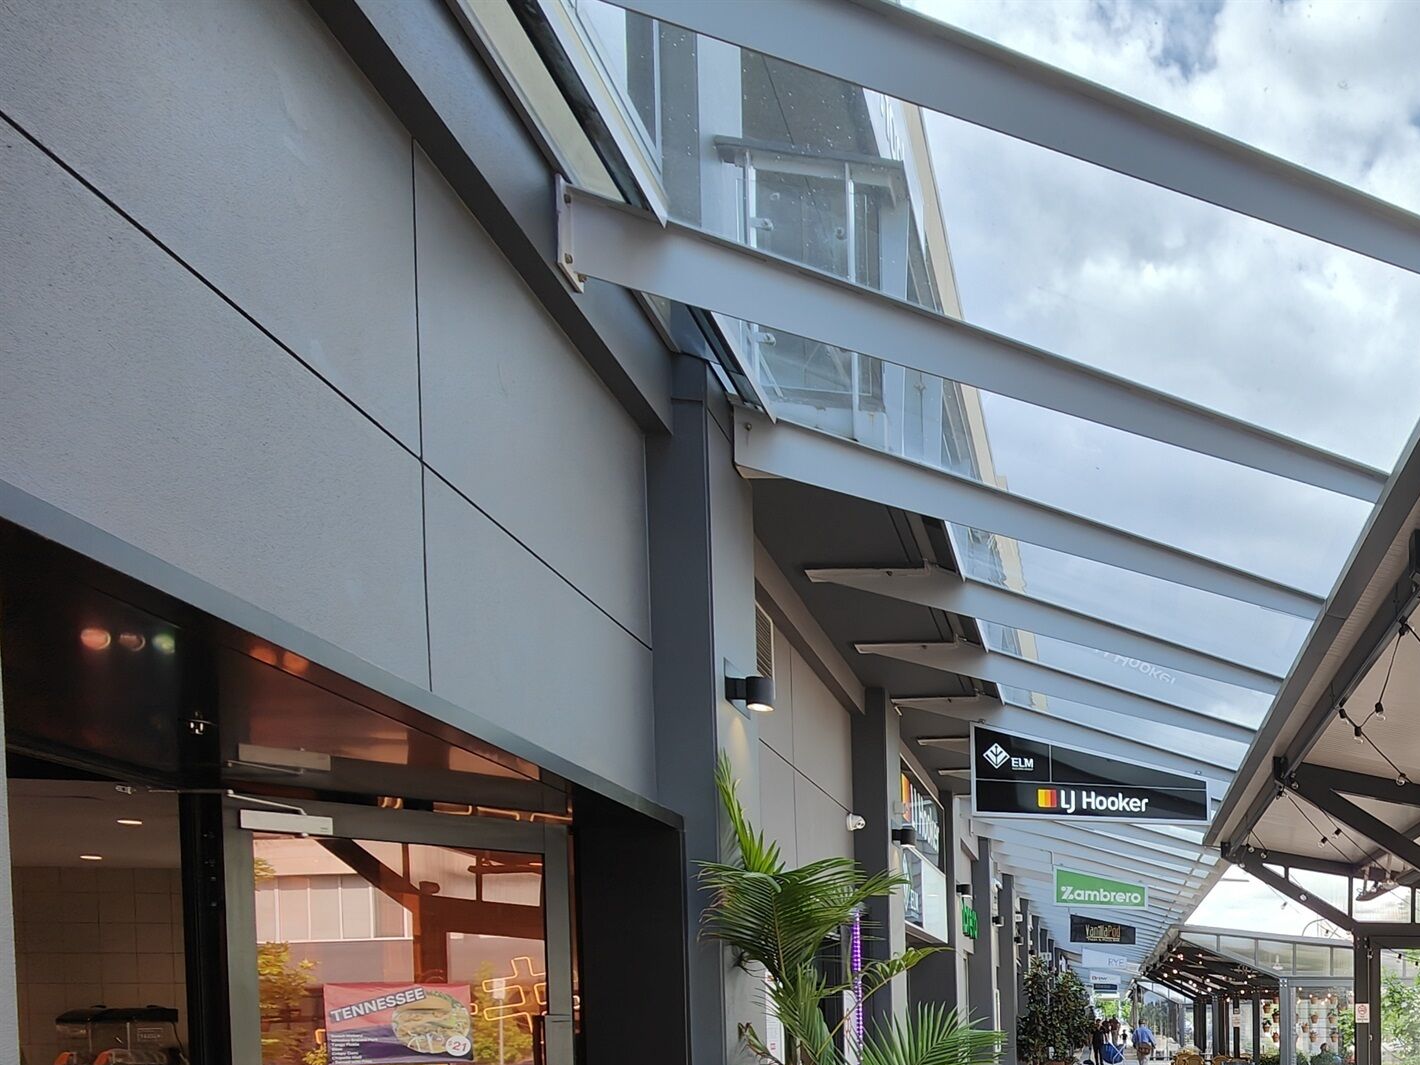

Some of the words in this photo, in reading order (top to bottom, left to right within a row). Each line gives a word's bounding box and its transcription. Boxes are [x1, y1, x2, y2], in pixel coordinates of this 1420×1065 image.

[1010, 757, 1034, 769] ELM
[1060, 789, 1076, 814] LJ
[1082, 791, 1149, 813] Hooker
[1060, 886, 1141, 904] Zambrero
[1108, 957, 1125, 967] RYE
[330, 987, 425, 1022] TENNESSEE
